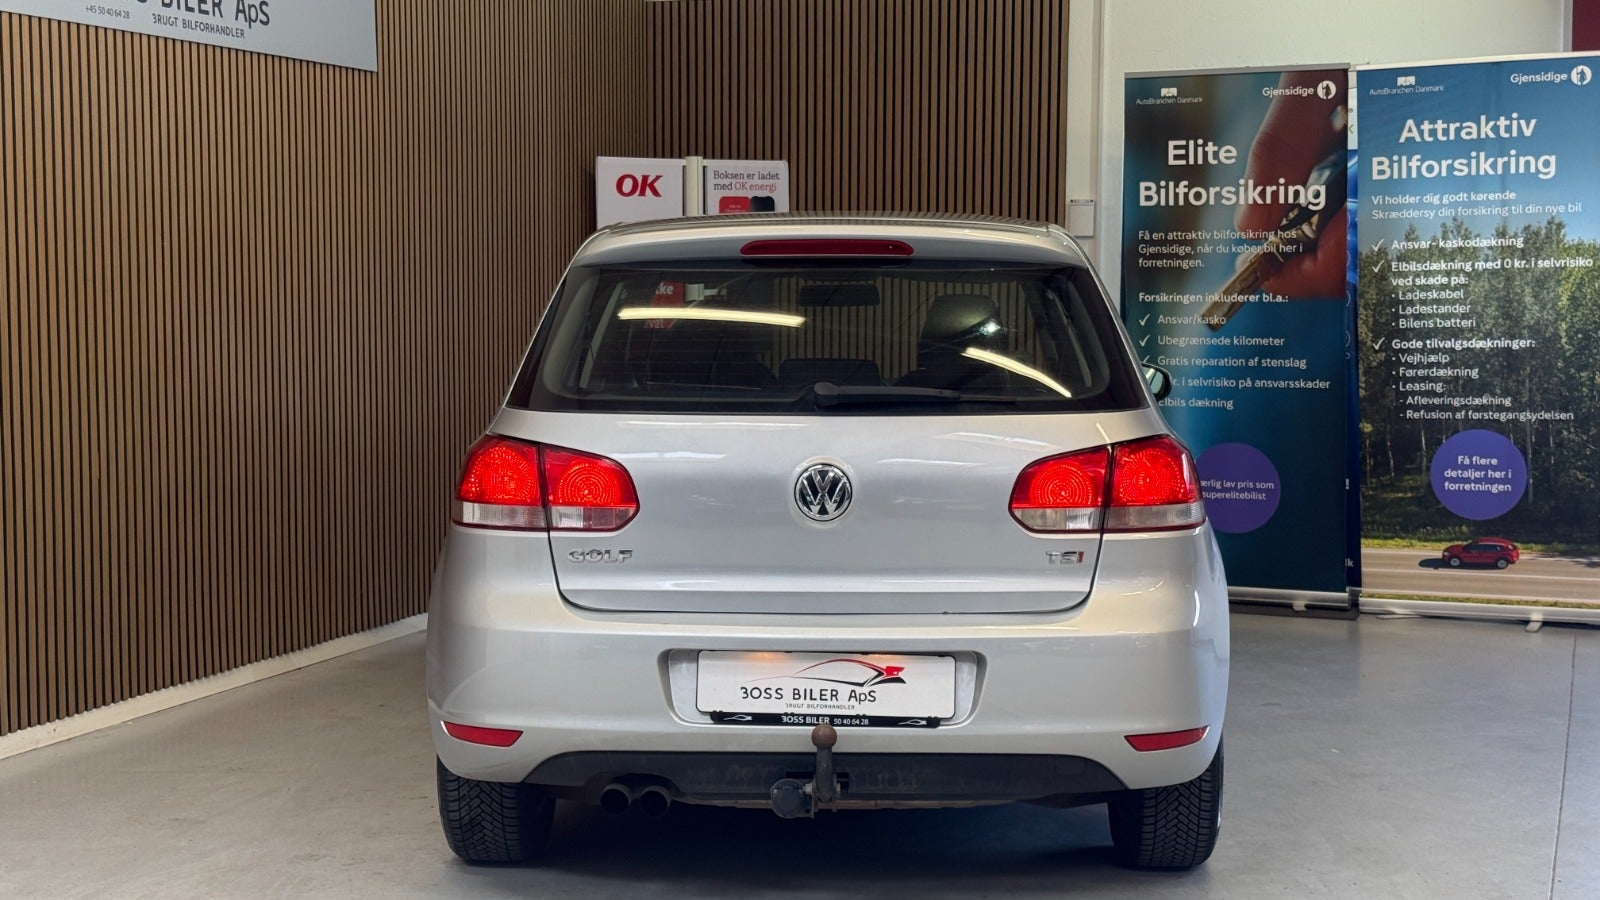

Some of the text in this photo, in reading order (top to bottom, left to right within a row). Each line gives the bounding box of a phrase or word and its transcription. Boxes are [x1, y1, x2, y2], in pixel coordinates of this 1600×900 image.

[235, 0, 270, 29] ApS
[182, 18, 245, 39] BILFORHANDLER
[1510, 72, 1568, 86] Gjensidige
[1262, 86, 1314, 99] Gjensidige
[1415, 85, 1444, 93] Danmark
[1177, 96, 1203, 104] Danmark
[1398, 112, 1537, 144] Attraktiv
[1167, 138, 1238, 166] Elite
[1371, 150, 1557, 180] Bilforsikring
[713, 170, 745, 180] Boksen
[758, 170, 780, 180] ladet
[615, 173, 664, 198] OK
[713, 182, 777, 193] med OK energi
[1138, 178, 1326, 211] Bilforsikring
[1372, 190, 1516, 205] Vi holder dig godt kørende
[1372, 202, 1582, 220] Skræddersy din forsikring til din nye bil
[1138, 230, 1150, 240] Få
[1166, 230, 1212, 240] attraktiv
[1214, 230, 1275, 242] bilforsikring
[1277, 229, 1297, 239] hos
[1439, 236, 1524, 248] kaskodækning
[1138, 243, 1302, 256] Gjensidige, når du køber bil her i
[1138, 258, 1204, 270] forretningen.
[1392, 256, 1593, 272] Elbilsdækning med 0 kr. i selvrisiko
[1392, 274, 1468, 288] ved skade på:
[1138, 292, 1288, 304] Forsikringen inkluderer bl.a.:
[1399, 290, 1464, 300] Ladeskabel
[1399, 304, 1471, 314] Ladestander
[1158, 314, 1226, 325] Ansvar/kasko
[1399, 318, 1476, 328] Bilens batteri
[1158, 336, 1285, 347] Ubegrænsede kilometer
[1392, 338, 1536, 350] Gode tilvalgsdækninger:
[1158, 356, 1306, 369] Gratis reparation af stenslag
[1399, 353, 1450, 364] Vejhjælp
[1400, 366, 1479, 379] Førerdækning
[1182, 377, 1185, 386] i
[1188, 377, 1236, 388] selvrisiko
[1238, 377, 1252, 389] på
[1254, 378, 1330, 390] ansvarsskader
[1400, 381, 1446, 393] Leasing:
[1188, 398, 1234, 410] dækning
[1406, 396, 1512, 407] Afleveringsdækning
[1406, 410, 1574, 422] Refusion af førstegangsydelsen
[1458, 454, 1498, 466] Få flere
[1444, 468, 1512, 480] detaljer her i
[1200, 480, 1222, 490] ærlig
[1223, 480, 1236, 488] lav
[1238, 480, 1254, 489] pris
[1444, 482, 1512, 493] forretningen
[1202, 491, 1266, 500] superelitebilist
[567, 548, 633, 564] GOLF
[792, 688, 839, 702] BILER
[847, 689, 877, 705] ApS
[806, 716, 830, 725] BILER
